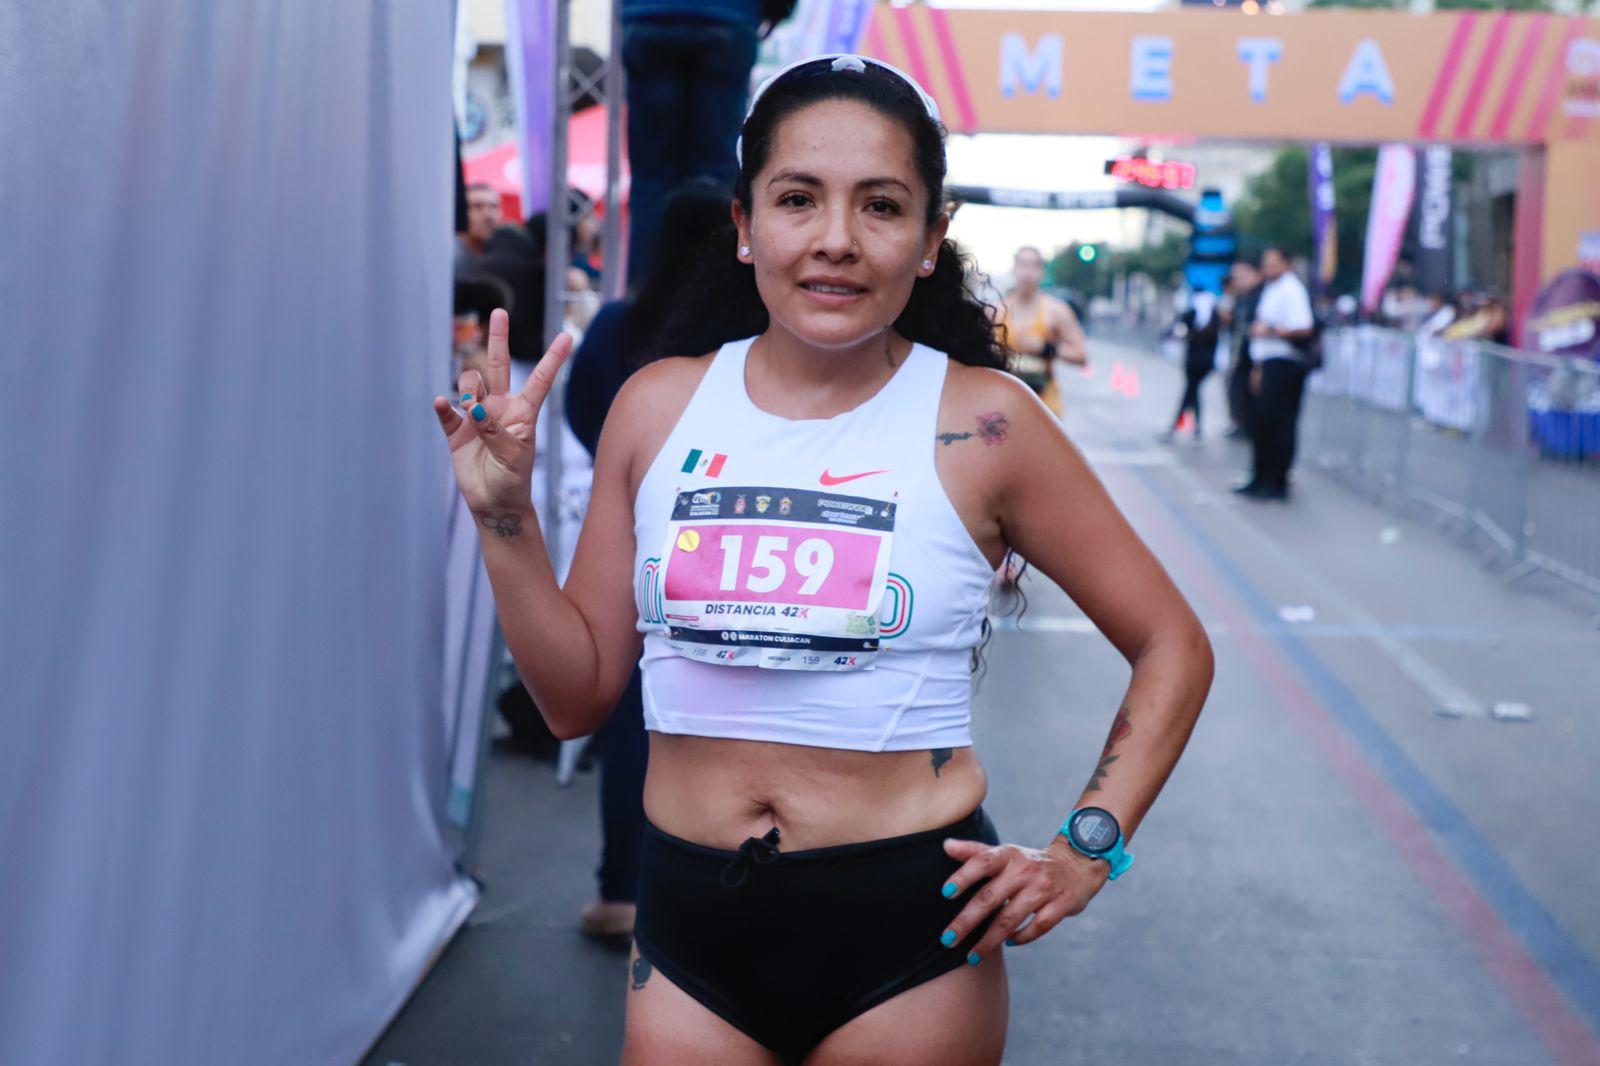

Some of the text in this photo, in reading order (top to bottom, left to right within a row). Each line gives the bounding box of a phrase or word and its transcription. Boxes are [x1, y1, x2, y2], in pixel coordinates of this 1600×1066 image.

[999, 31, 1396, 105] META
[719, 534, 834, 595] 159
[705, 603, 776, 617] DISTANCIA
[780, 606, 810, 619] 42K
[738, 633, 811, 645] MARATON CULIACAN
[802, 656, 820, 665] 159
[833, 656, 857, 666] 42K
